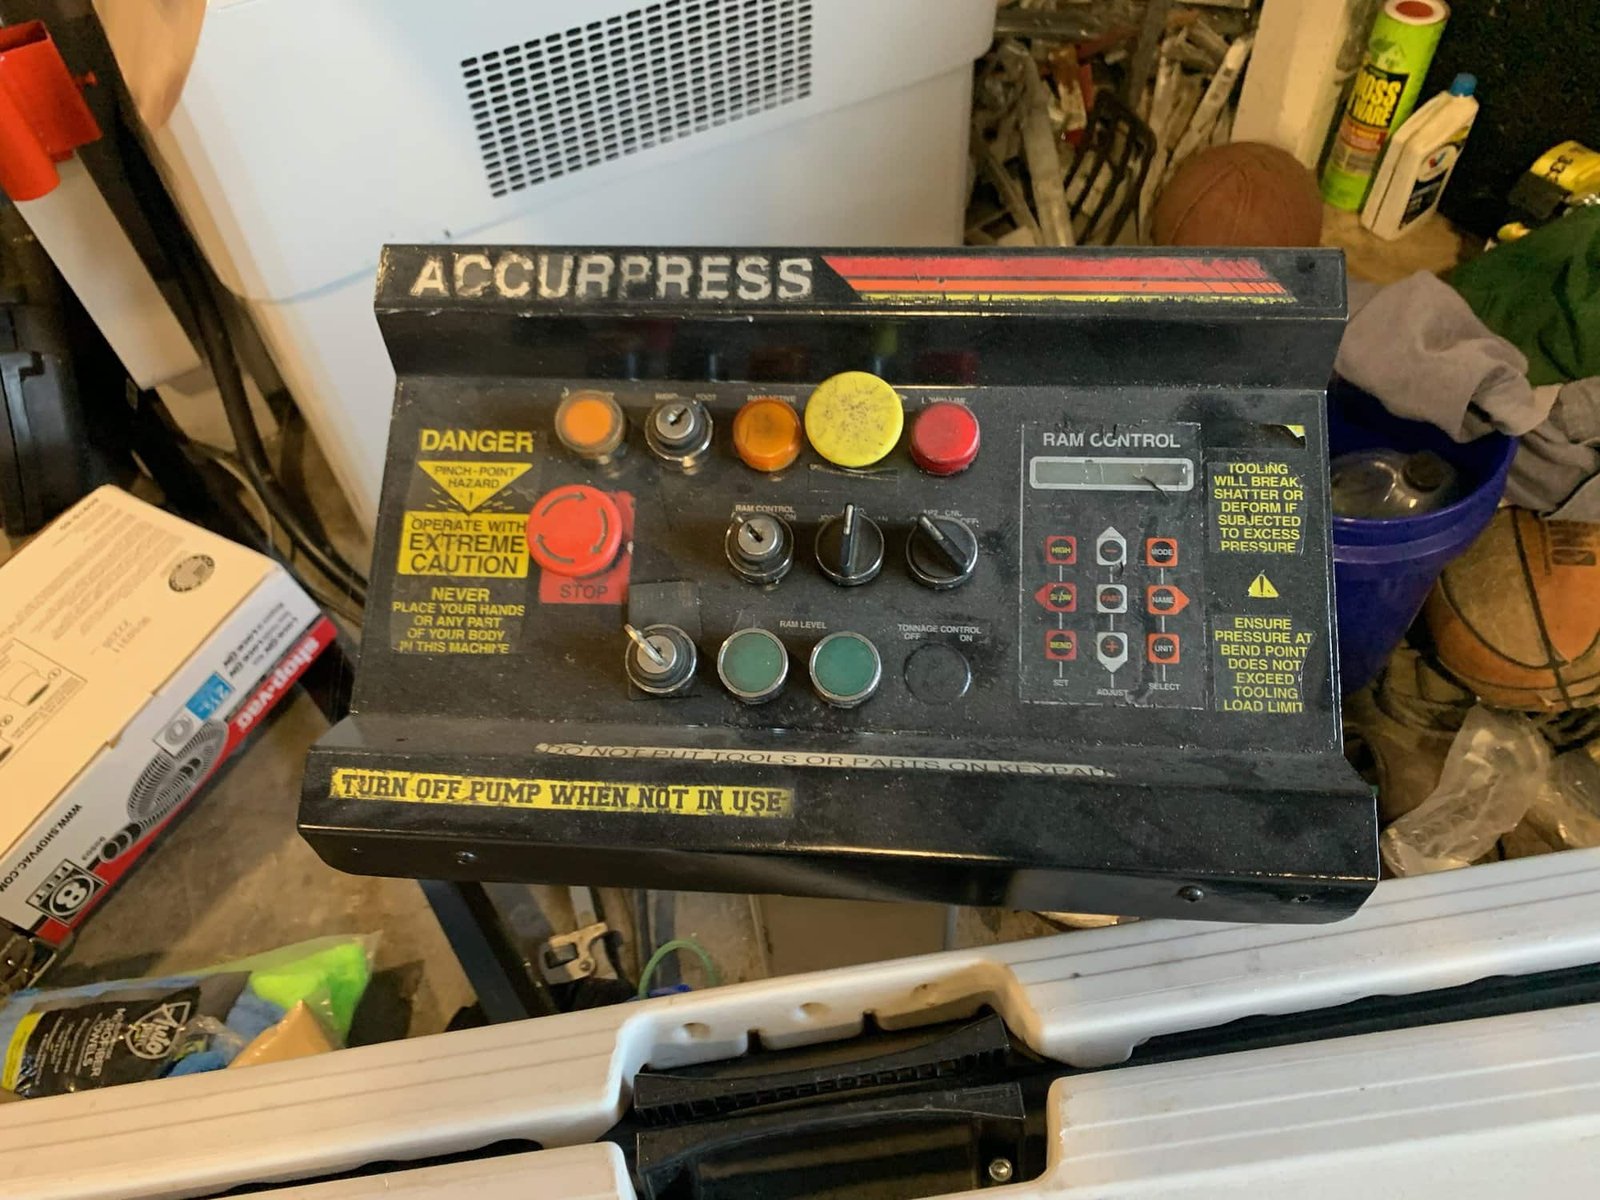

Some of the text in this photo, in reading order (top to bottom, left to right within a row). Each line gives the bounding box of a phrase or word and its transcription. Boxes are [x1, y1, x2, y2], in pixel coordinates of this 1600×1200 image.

[411, 252, 813, 299] ACCURPRESS
[421, 429, 534, 453] DANGER
[1043, 432, 1181, 448] RAM CONTROL
[1229, 462, 1289, 474] TOOLING
[448, 478, 501, 489] HAZARD
[1214, 475, 1303, 489] WILL BREAK,
[1214, 488, 1304, 500] SHATTER OR
[735, 504, 796, 514] RAM CONTROL
[1221, 501, 1297, 513] DEFORM IF
[411, 518, 527, 533] OPERATE WITH
[1218, 514, 1301, 526] SUBJECTED
[1220, 527, 1300, 540] TO EXCESS
[409, 533, 525, 554] EXTREME
[1221, 540, 1296, 553] PRESSURE
[411, 553, 518, 575] CAUTION
[431, 587, 490, 601] NEVER
[560, 584, 608, 600] STOP
[392, 601, 526, 616] PLACE YOUR HANDS
[414, 615, 504, 628] OR ANY PART
[779, 619, 828, 630] RAM LEVEL
[1234, 617, 1292, 630] ENSURE
[408, 627, 506, 641] OF YOUR BODY
[897, 623, 981, 635] TONNAGE CONTROL
[904, 633, 973, 642] OFF ON
[1215, 630, 1312, 644] PRESSURE AT
[417, 640, 447, 652] THIS
[1050, 641, 1073, 650] BEND
[1154, 644, 1174, 652] UNIT
[1221, 644, 1307, 657] BEND POINT
[1228, 658, 1301, 671] DOES NOT
[1053, 679, 1069, 687] SET
[1236, 672, 1295, 685] EXCEED
[1096, 688, 1129, 697] ADJUST
[1148, 682, 1180, 691] SELECT
[1233, 686, 1298, 699] TOOLING
[1224, 699, 1303, 713] LOAD LIMIT
[546, 744, 582, 755] DO
[590, 746, 647, 757] NOT
[652, 749, 705, 760] PUT
[710, 752, 797, 764] TOOLS
[805, 756, 843, 766] OR
[853, 757, 941, 769] PARTS
[949, 761, 988, 772] ON
[342, 774, 782, 812] TURN OFF PUMP WHEN NOT IN USE
[0, 804, 82, 893] WWW.SHOPVAC.COM
[36, 866, 69, 900] FEET
[56, 881, 89, 909] 8
